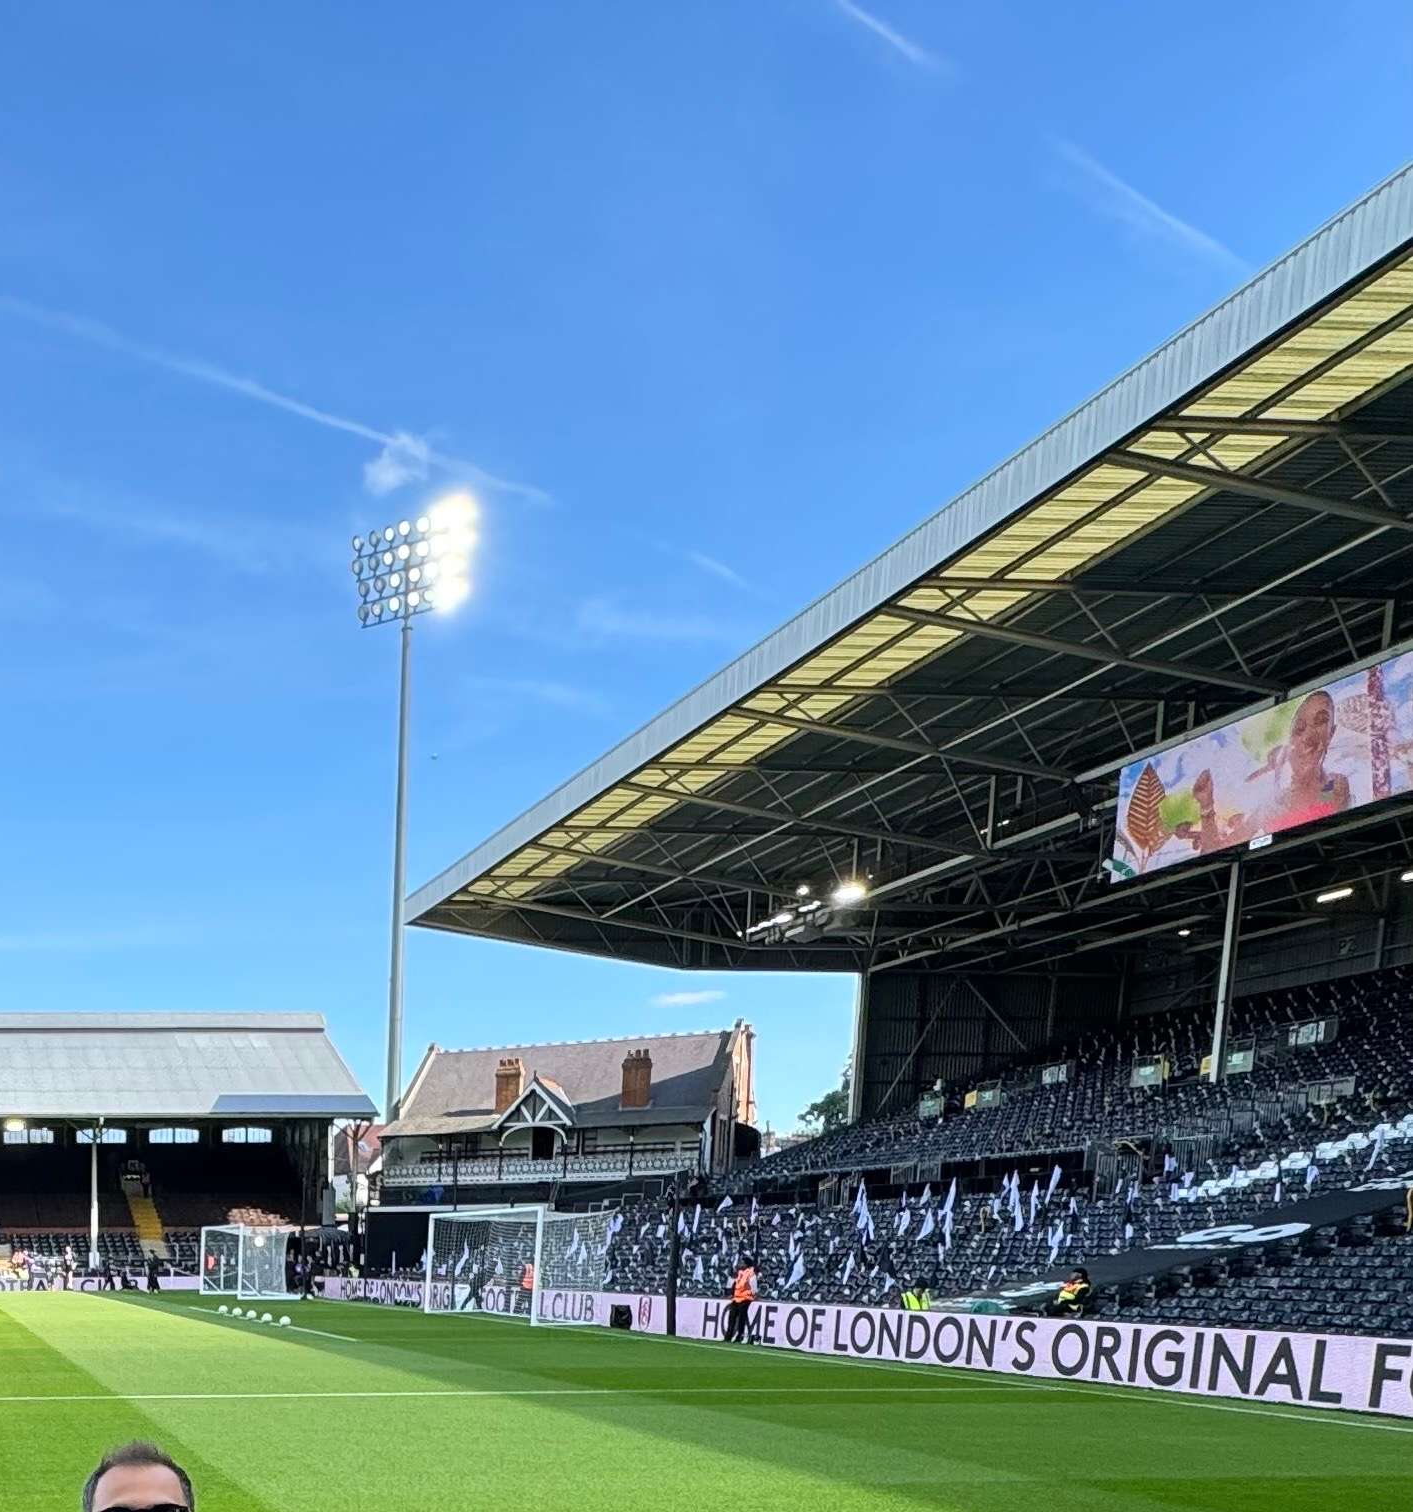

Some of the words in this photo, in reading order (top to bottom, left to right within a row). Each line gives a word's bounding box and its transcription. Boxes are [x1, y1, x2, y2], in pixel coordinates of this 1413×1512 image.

[552, 1292, 594, 1322] CLUB
[786, 1306, 826, 1348] OF
[833, 1309, 1037, 1371] LONDON'S
[1051, 1322, 1342, 1405] ORIGINAL
[1368, 1343, 1413, 1409] F
